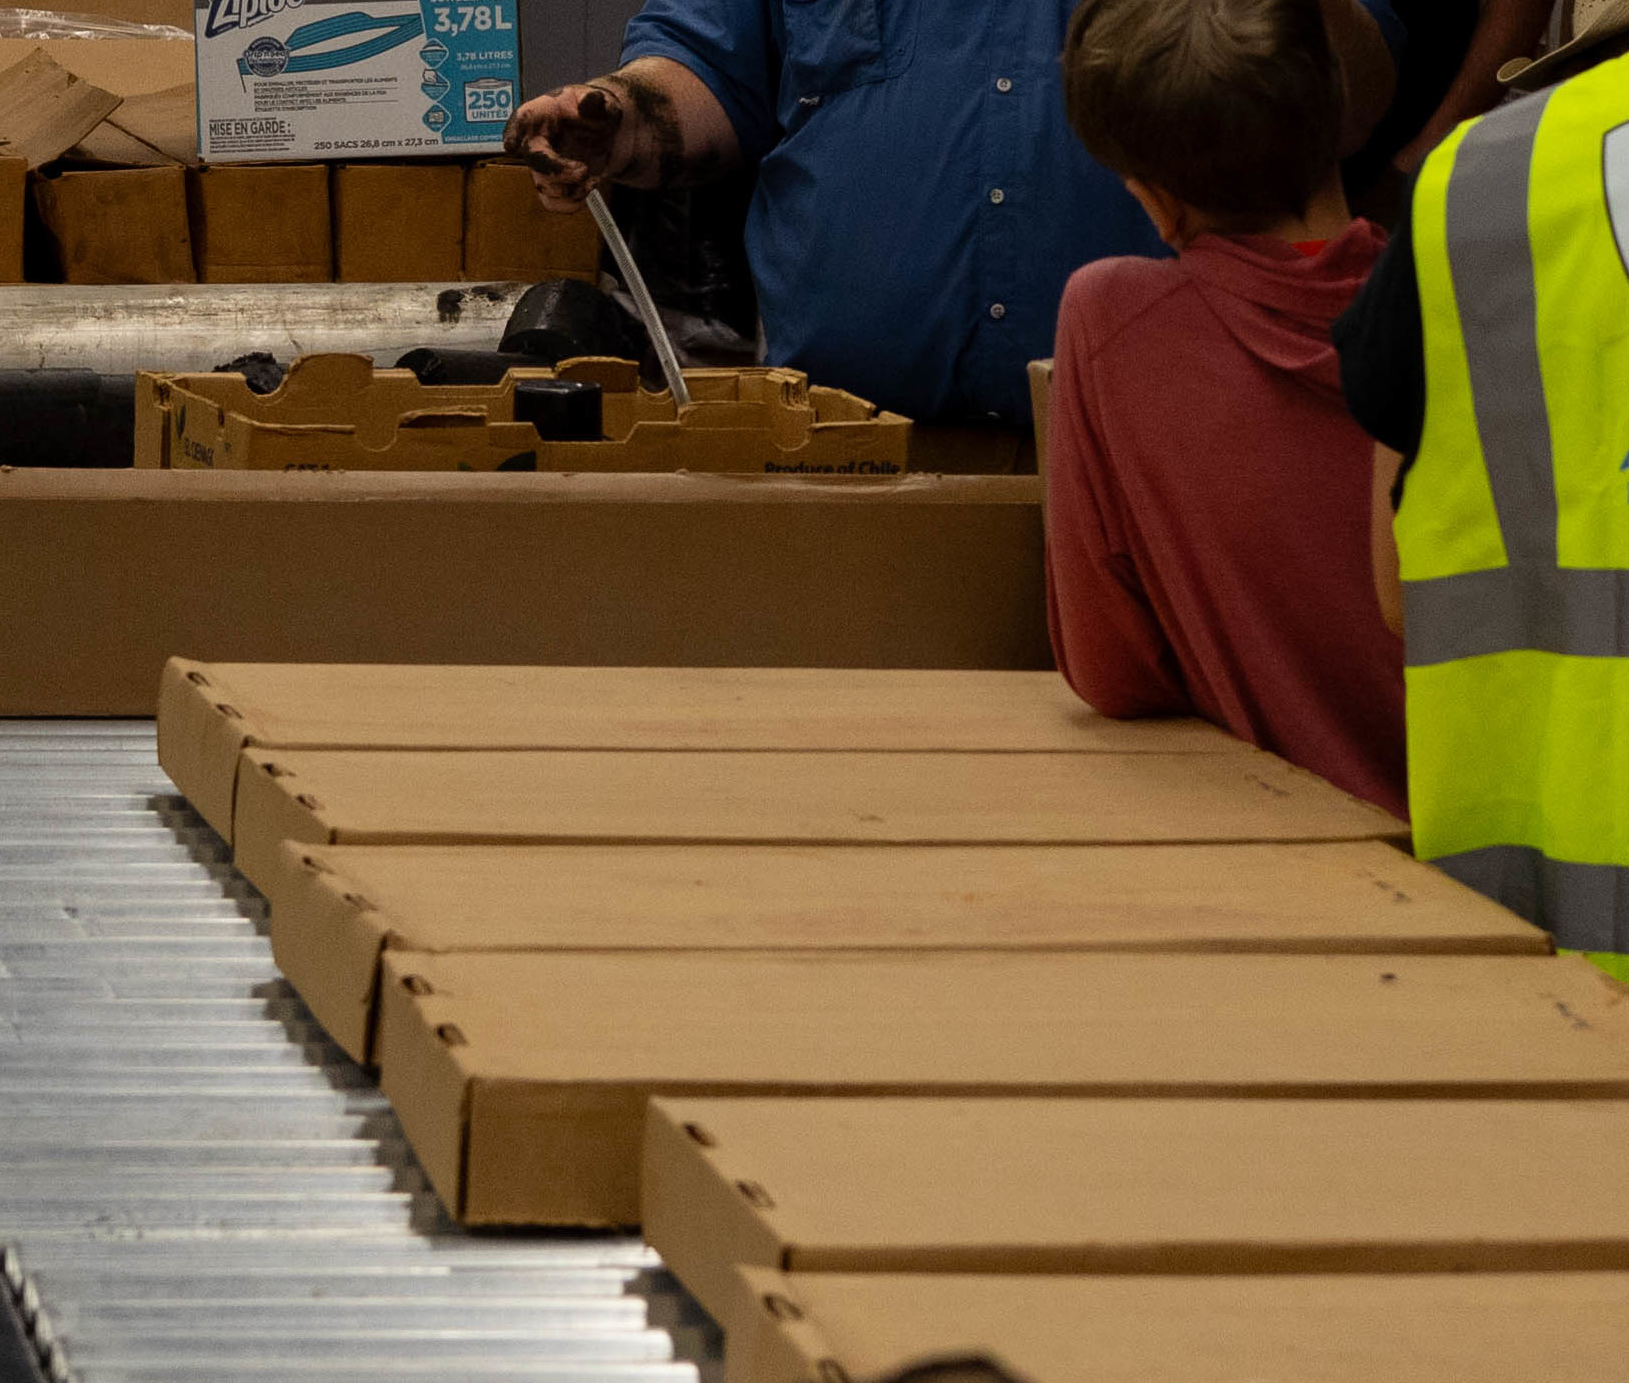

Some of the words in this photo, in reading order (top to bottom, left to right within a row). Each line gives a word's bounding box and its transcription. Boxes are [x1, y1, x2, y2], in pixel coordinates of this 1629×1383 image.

[478, 50, 514, 61] LITRES
[468, 89, 512, 110] 250
[472, 108, 509, 119] UNITÉS
[209, 123, 233, 136] MISE
[234, 122, 249, 135] EN
[250, 121, 285, 135] GARDE
[314, 141, 332, 151] 250
[334, 140, 358, 150] SACS
[360, 139, 380, 150] 26,8
[382, 139, 396, 148] cm
[404, 137, 423, 148] 27,3
[425, 137, 439, 146] cm
